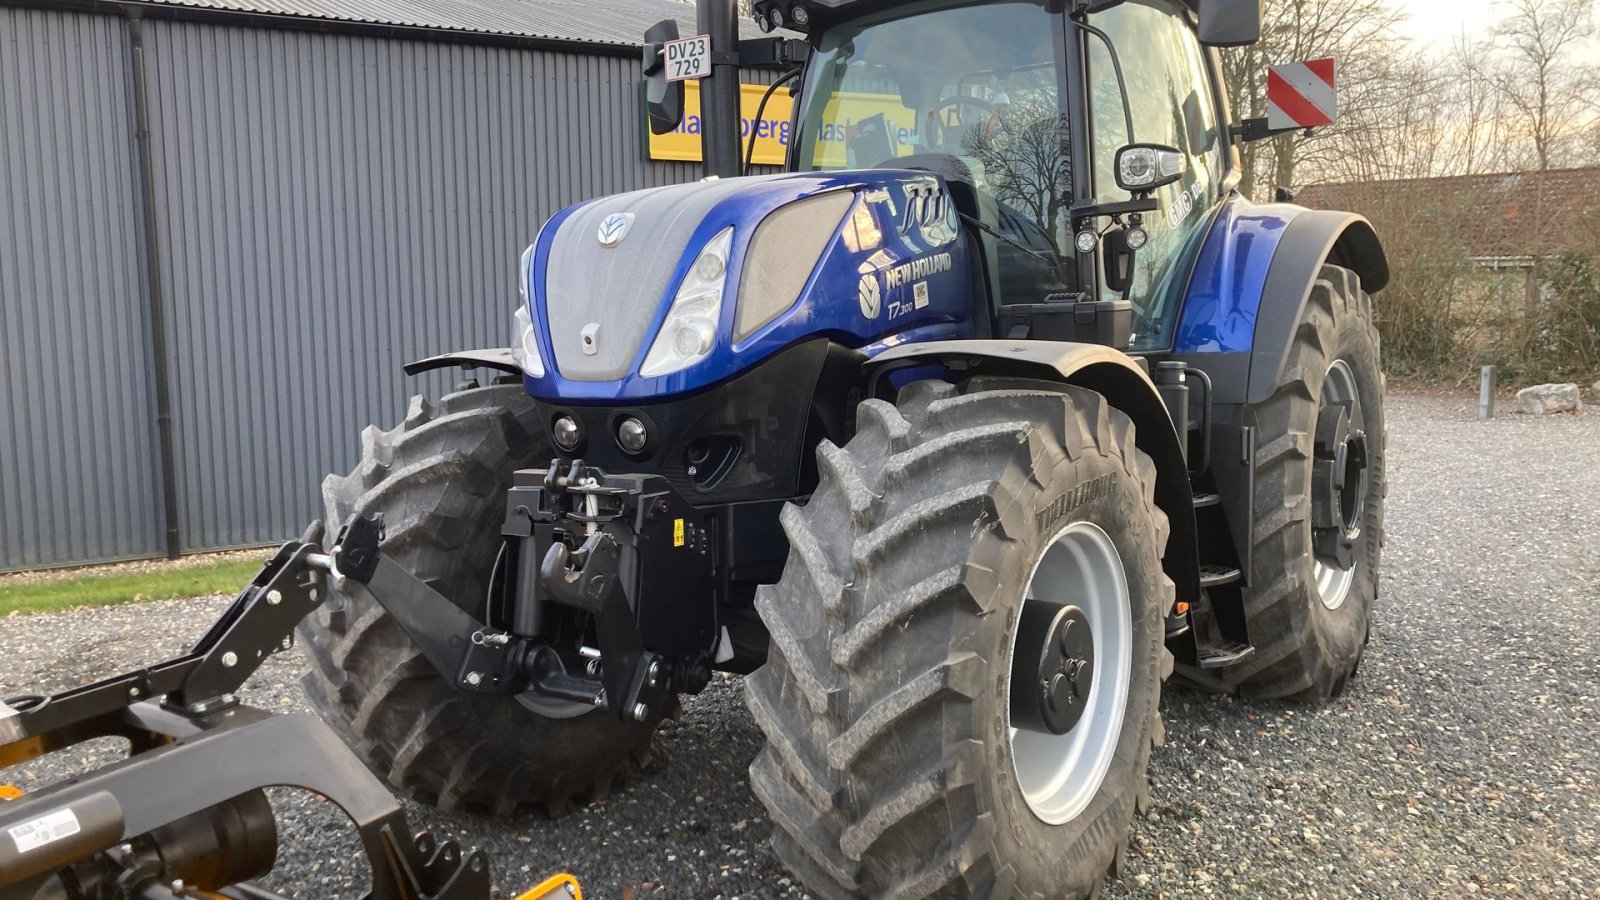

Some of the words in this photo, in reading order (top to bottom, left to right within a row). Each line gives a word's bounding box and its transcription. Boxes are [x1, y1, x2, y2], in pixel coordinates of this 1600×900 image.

[668, 39, 706, 61] DV23
[674, 58, 700, 77] 729
[1168, 193, 1191, 227] GMC
[885, 262, 911, 291] NEW
[911, 252, 952, 280] HOLLAND
